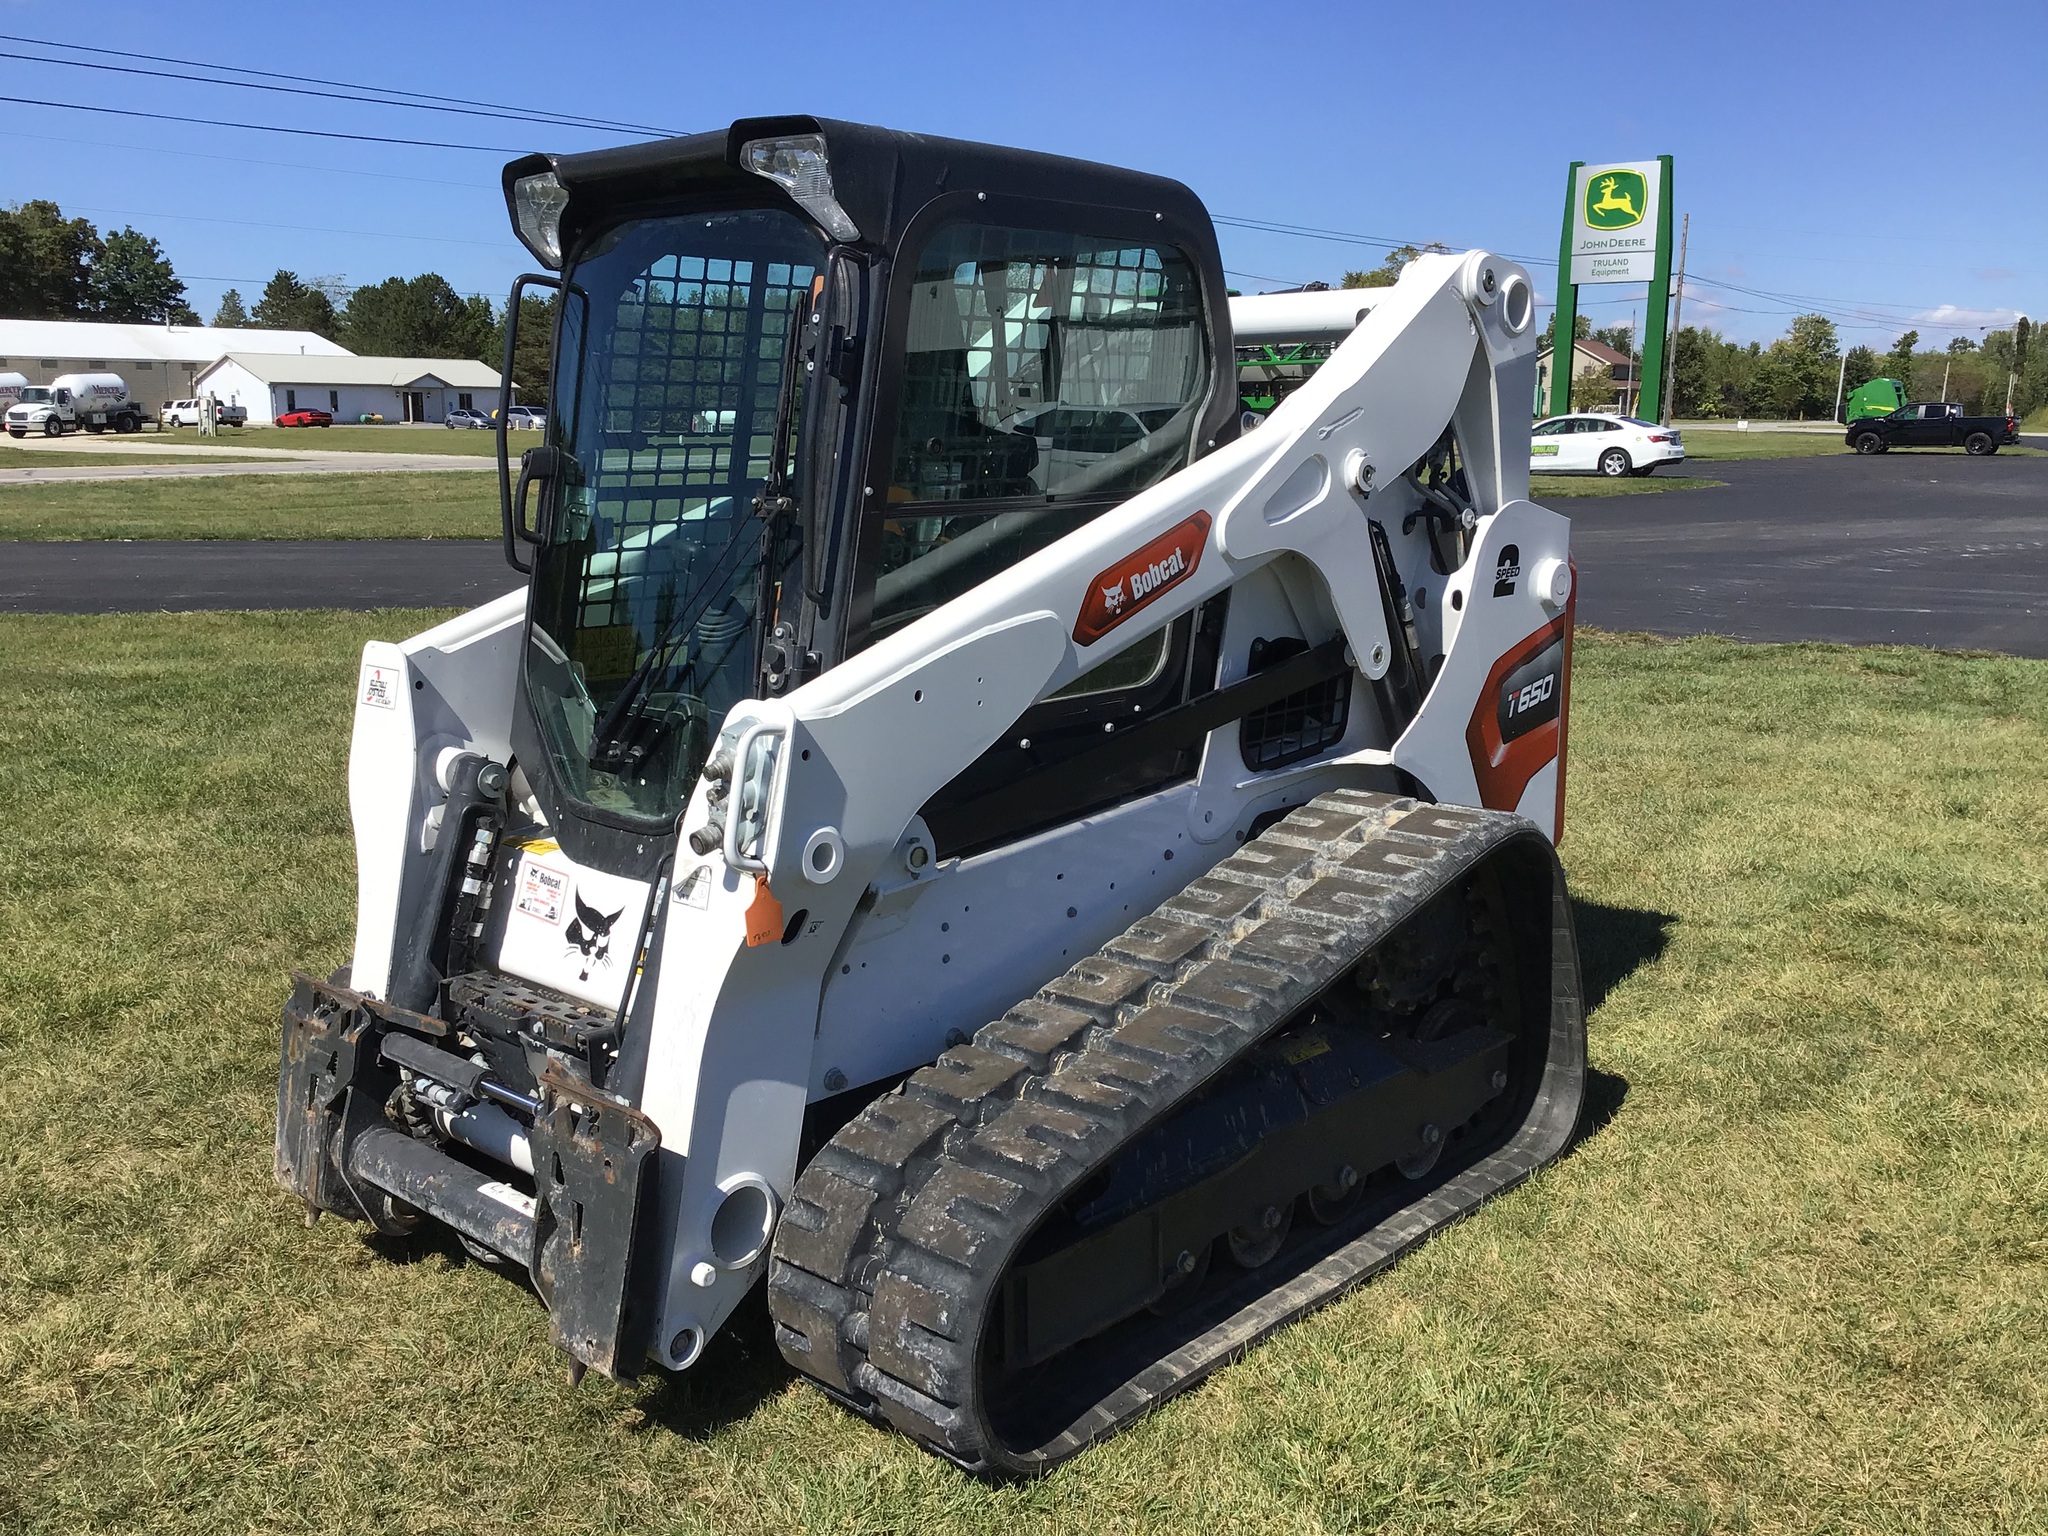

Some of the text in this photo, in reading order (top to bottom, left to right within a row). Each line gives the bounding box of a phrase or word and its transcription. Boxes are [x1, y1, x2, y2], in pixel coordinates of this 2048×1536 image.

[1580, 239, 1647, 250] JOHN DEERE
[1593, 258, 1629, 267] TRULAND
[1591, 268, 1630, 277] Equipment
[0, 386, 21, 394] ERCER
[92, 384, 120, 395] MERCER
[1130, 546, 1185, 600] Bobcat
[1493, 543, 1520, 598] 2
[1495, 567, 1520, 580] SPEED
[1508, 673, 1554, 719] T650
[539, 872, 562, 890] Bobcat
